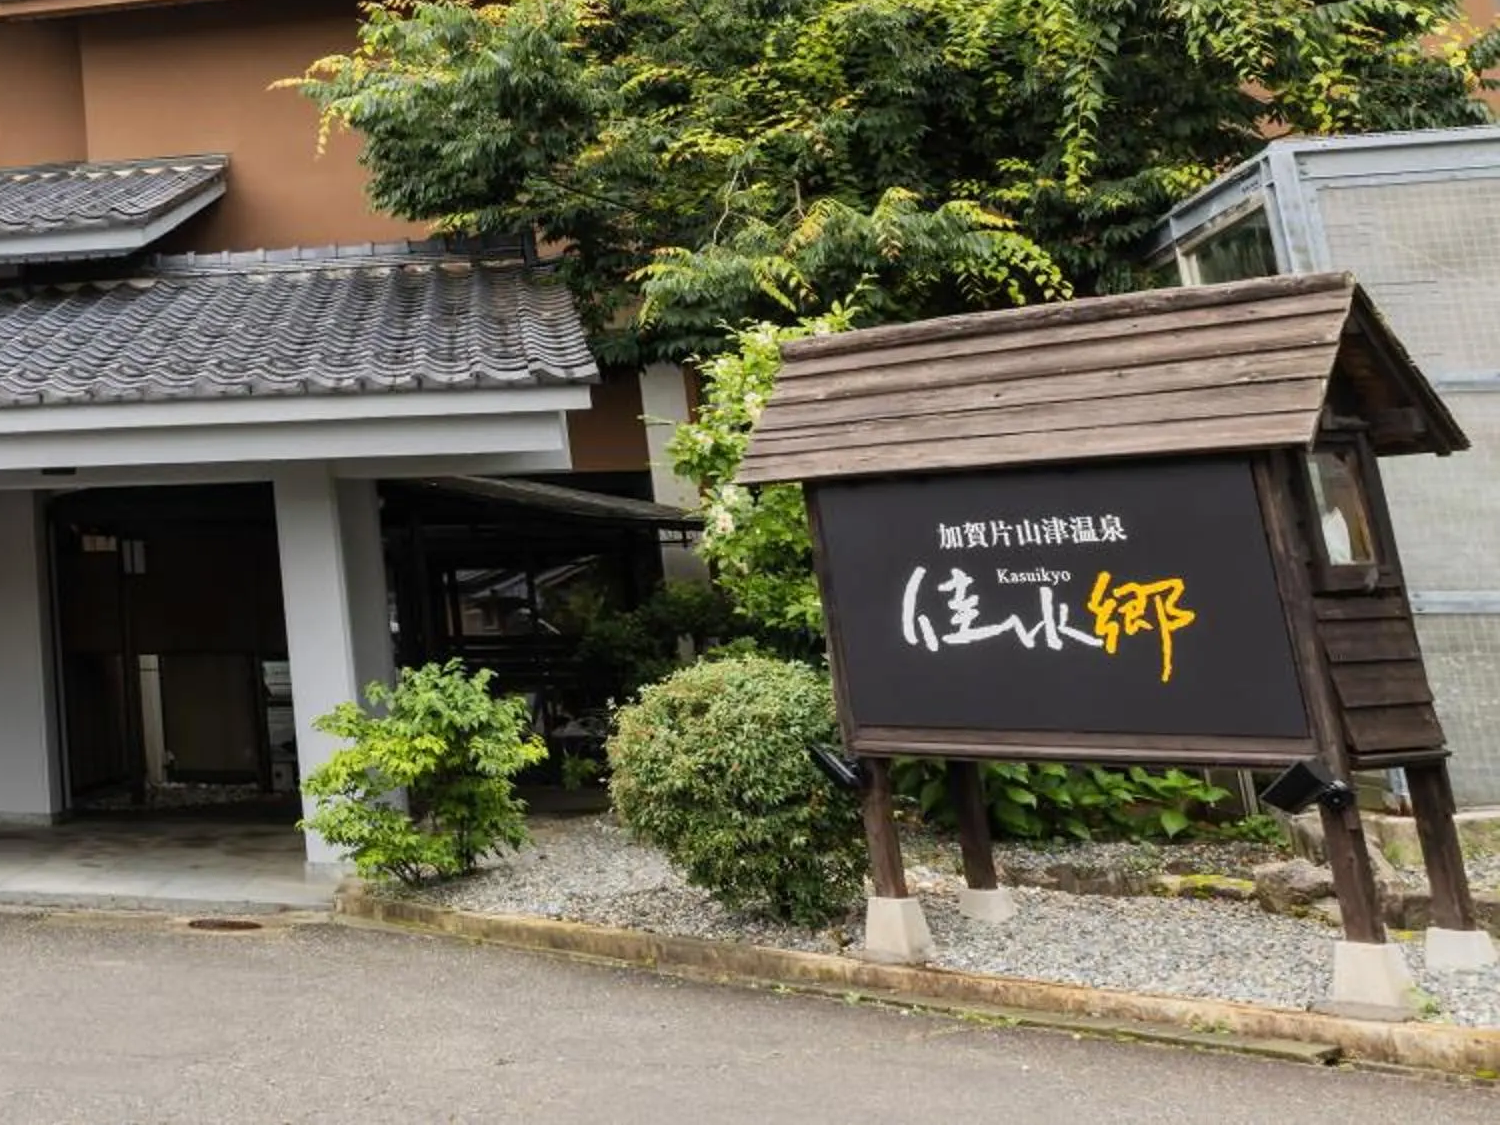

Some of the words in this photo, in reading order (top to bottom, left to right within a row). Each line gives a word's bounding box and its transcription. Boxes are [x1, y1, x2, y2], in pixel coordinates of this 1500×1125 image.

[938, 515, 1128, 549] 加賀片山津温泉
[997, 567, 1071, 586] Kasuikyo
[902, 566, 1195, 682] 佳水郷
